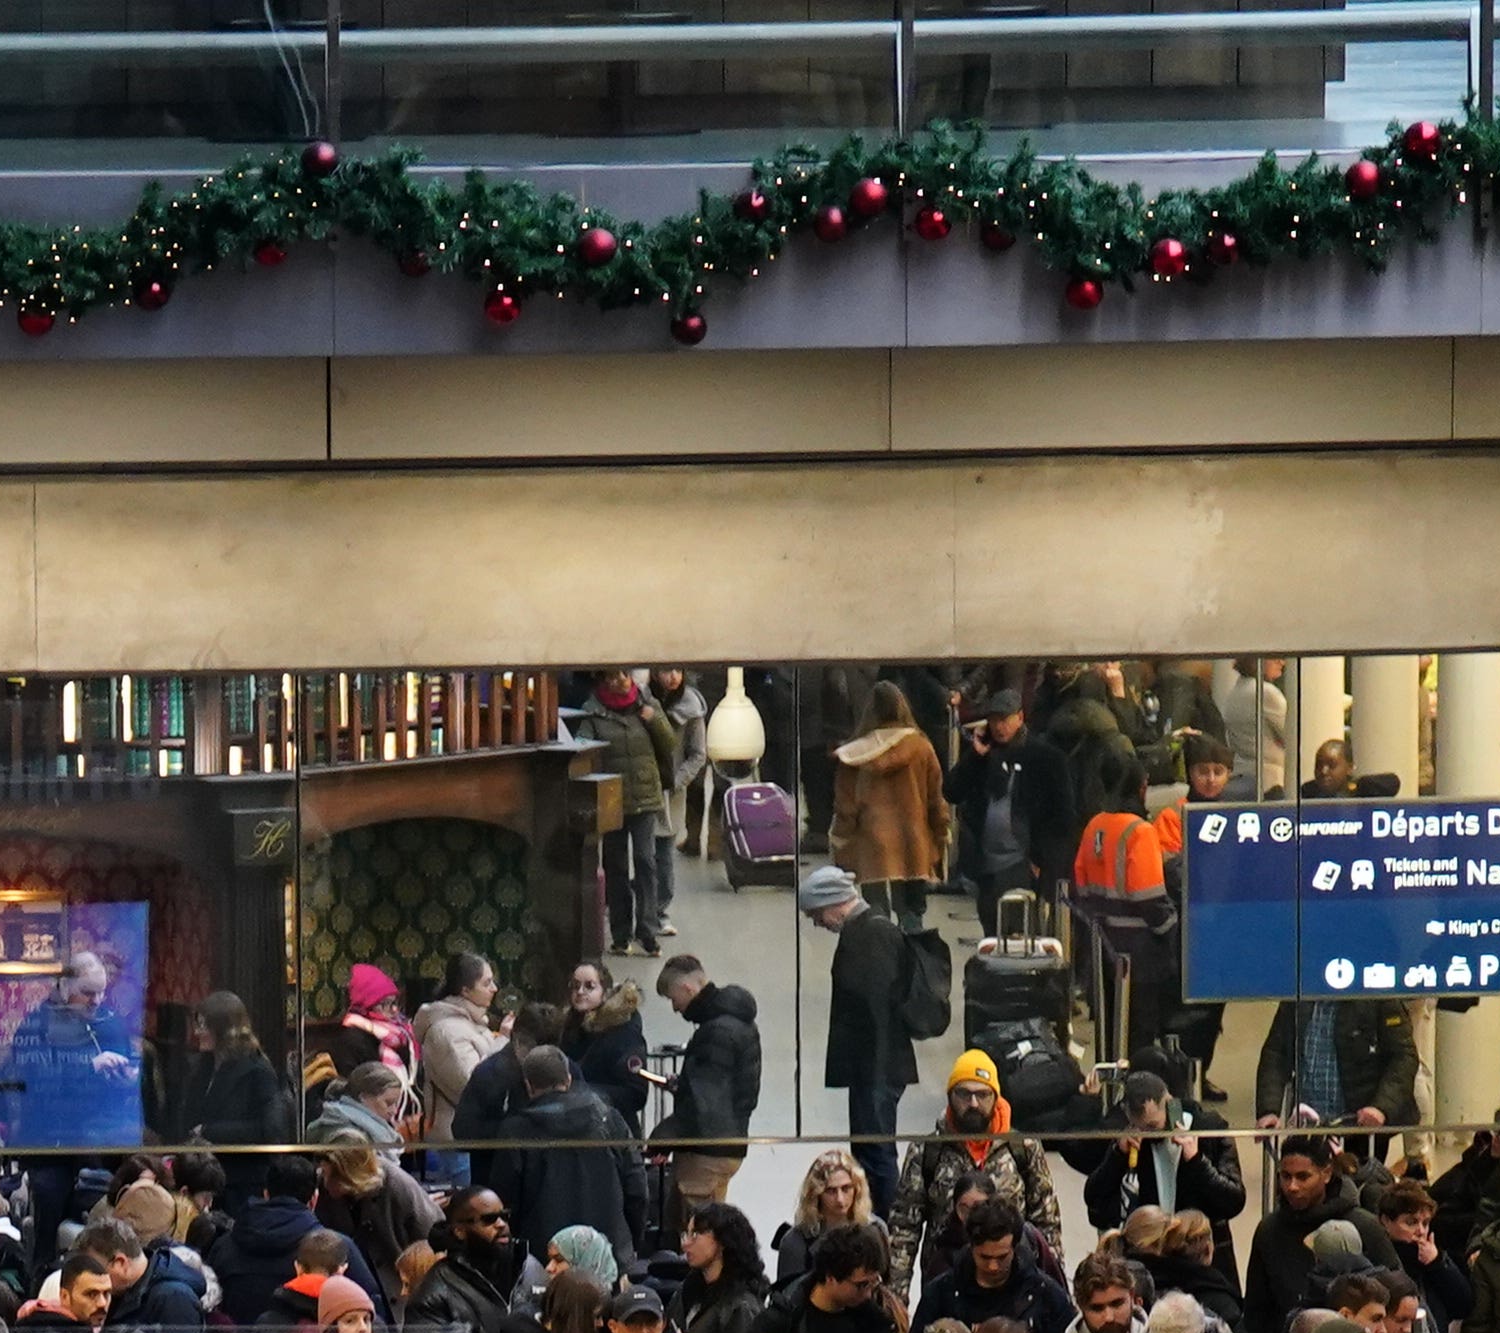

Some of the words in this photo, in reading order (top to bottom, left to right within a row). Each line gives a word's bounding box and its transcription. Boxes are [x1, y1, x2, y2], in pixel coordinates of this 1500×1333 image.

[1372, 809, 1480, 843] Départs
[1384, 857, 1431, 873] Tickets
[1433, 857, 1458, 872] and
[1394, 872, 1457, 889] platforms
[1449, 920, 1489, 937] King's
